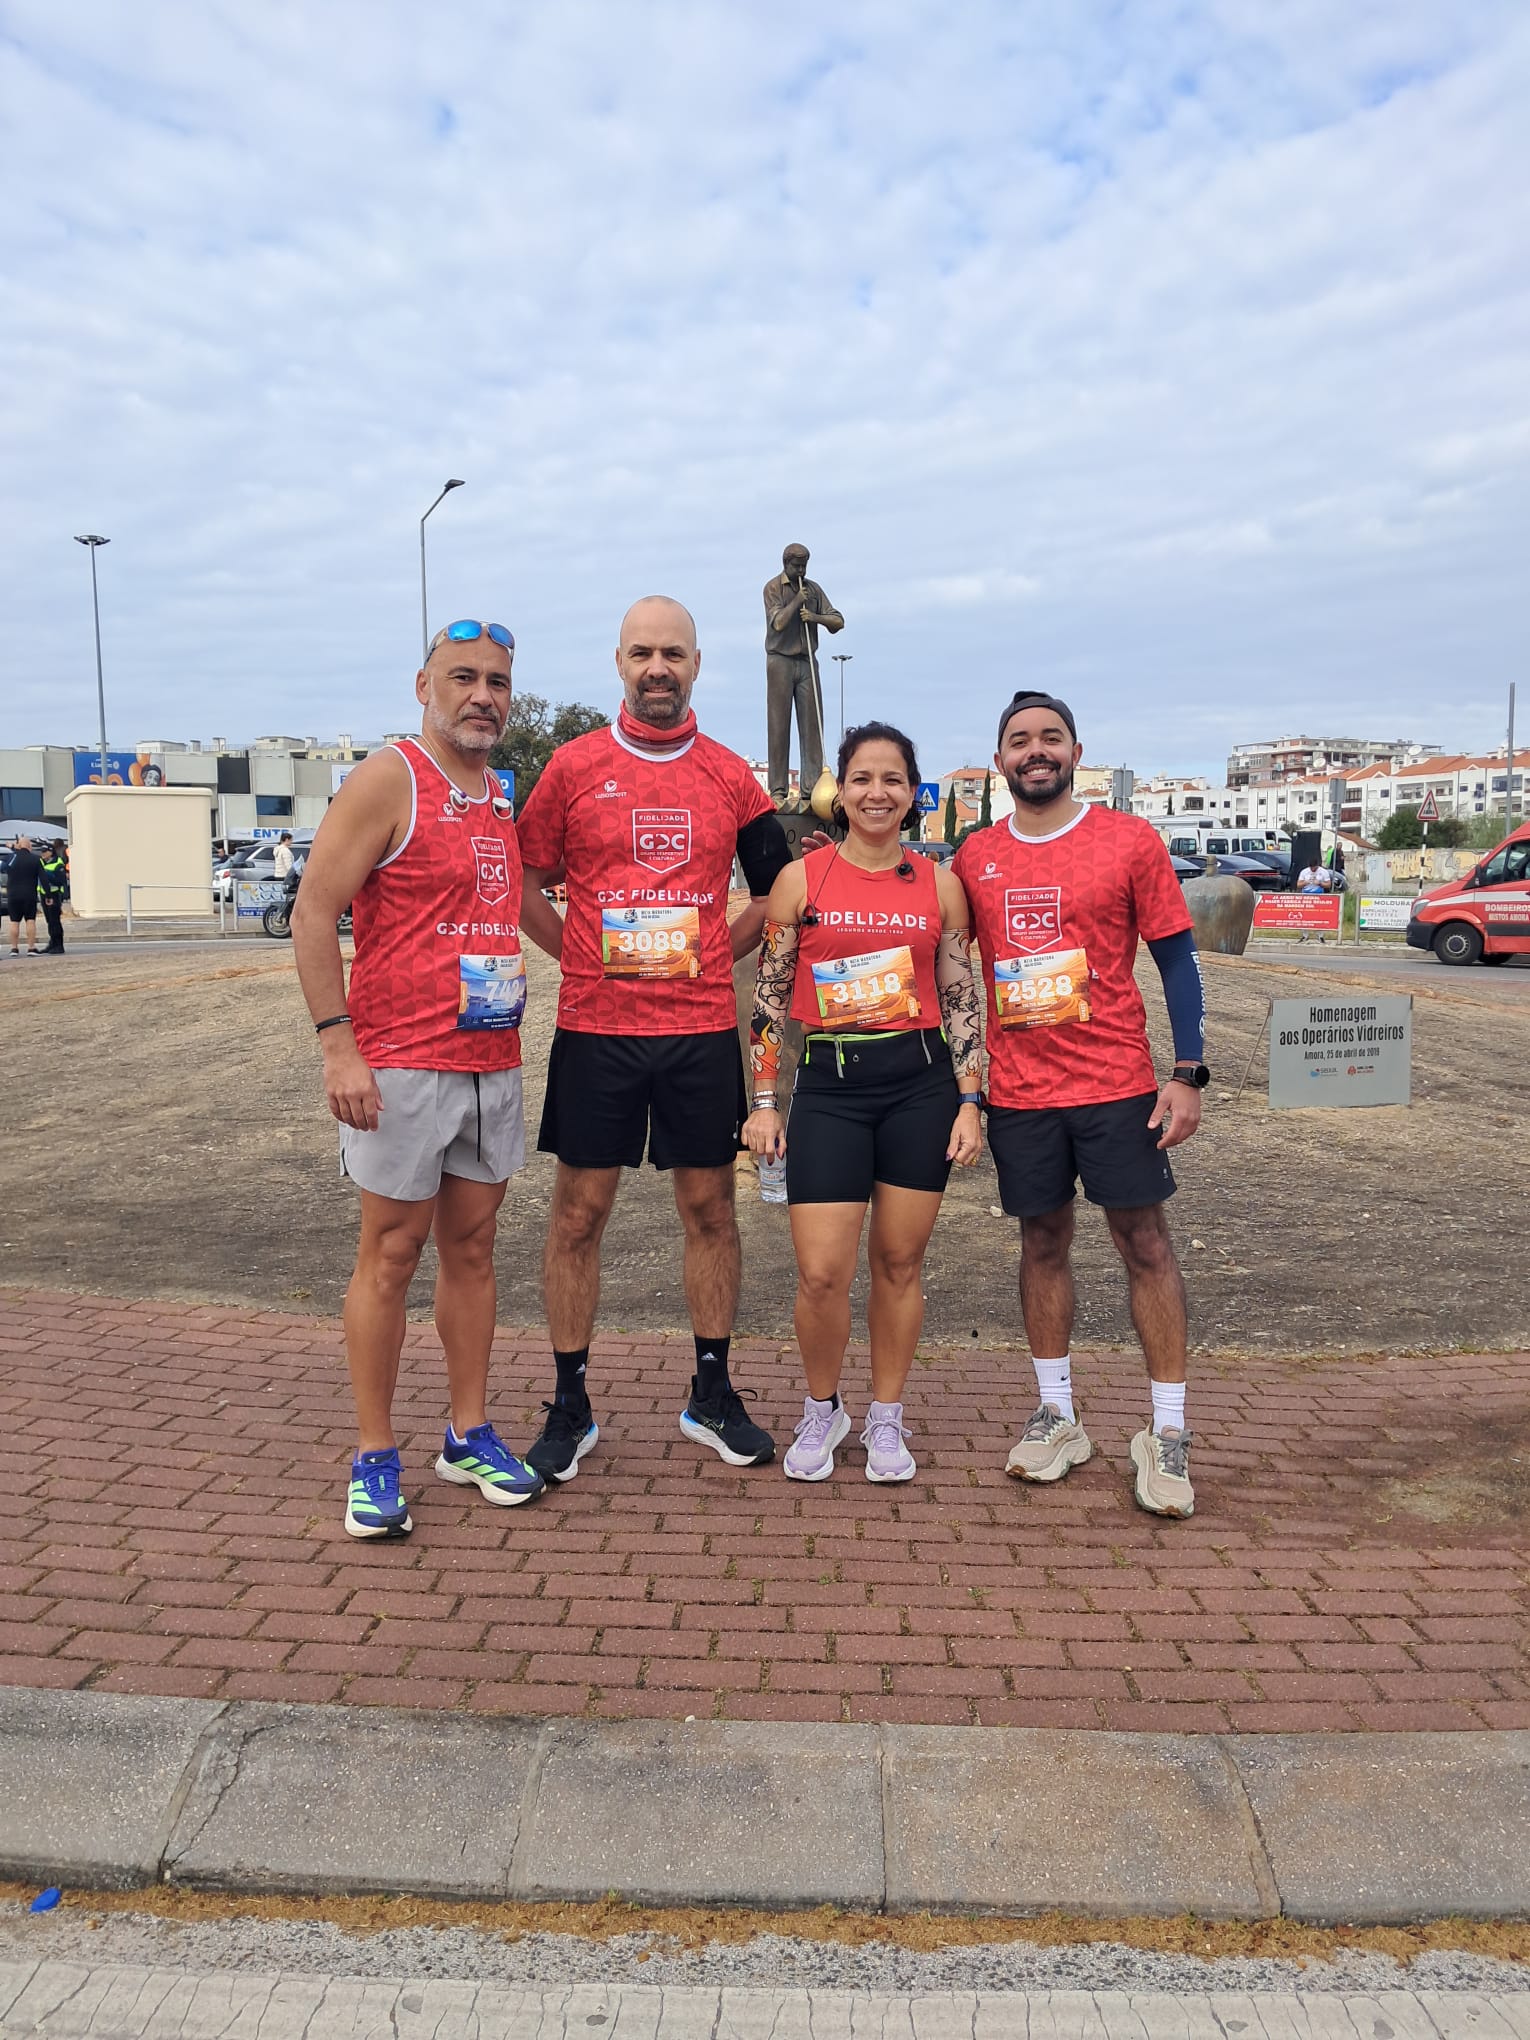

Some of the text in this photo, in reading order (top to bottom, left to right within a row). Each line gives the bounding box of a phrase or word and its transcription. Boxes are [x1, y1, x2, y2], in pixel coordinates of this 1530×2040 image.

[639, 833, 686, 850] GDC
[480, 862, 504, 881] GDC
[597, 889, 714, 905] GDC FIDELIDADE
[1010, 893, 1055, 902] FIDELIDADE
[436, 922, 519, 937] GDC FIDELID
[1011, 911, 1055, 930] GDC
[618, 930, 687, 953] 3089
[832, 972, 902, 1004] 3118
[1007, 974, 1073, 1003] 2528
[1309, 1006, 1377, 1023] Homenagem
[1279, 1024, 1404, 1047] aos Operários Vidreiros
[1304, 1051, 1326, 1060] Amora,
[1327, 1050, 1334, 1059] 25
[1335, 1050, 1342, 1058] de
[1344, 1048, 1357, 1058] abril
[1359, 1048, 1366, 1057] de
